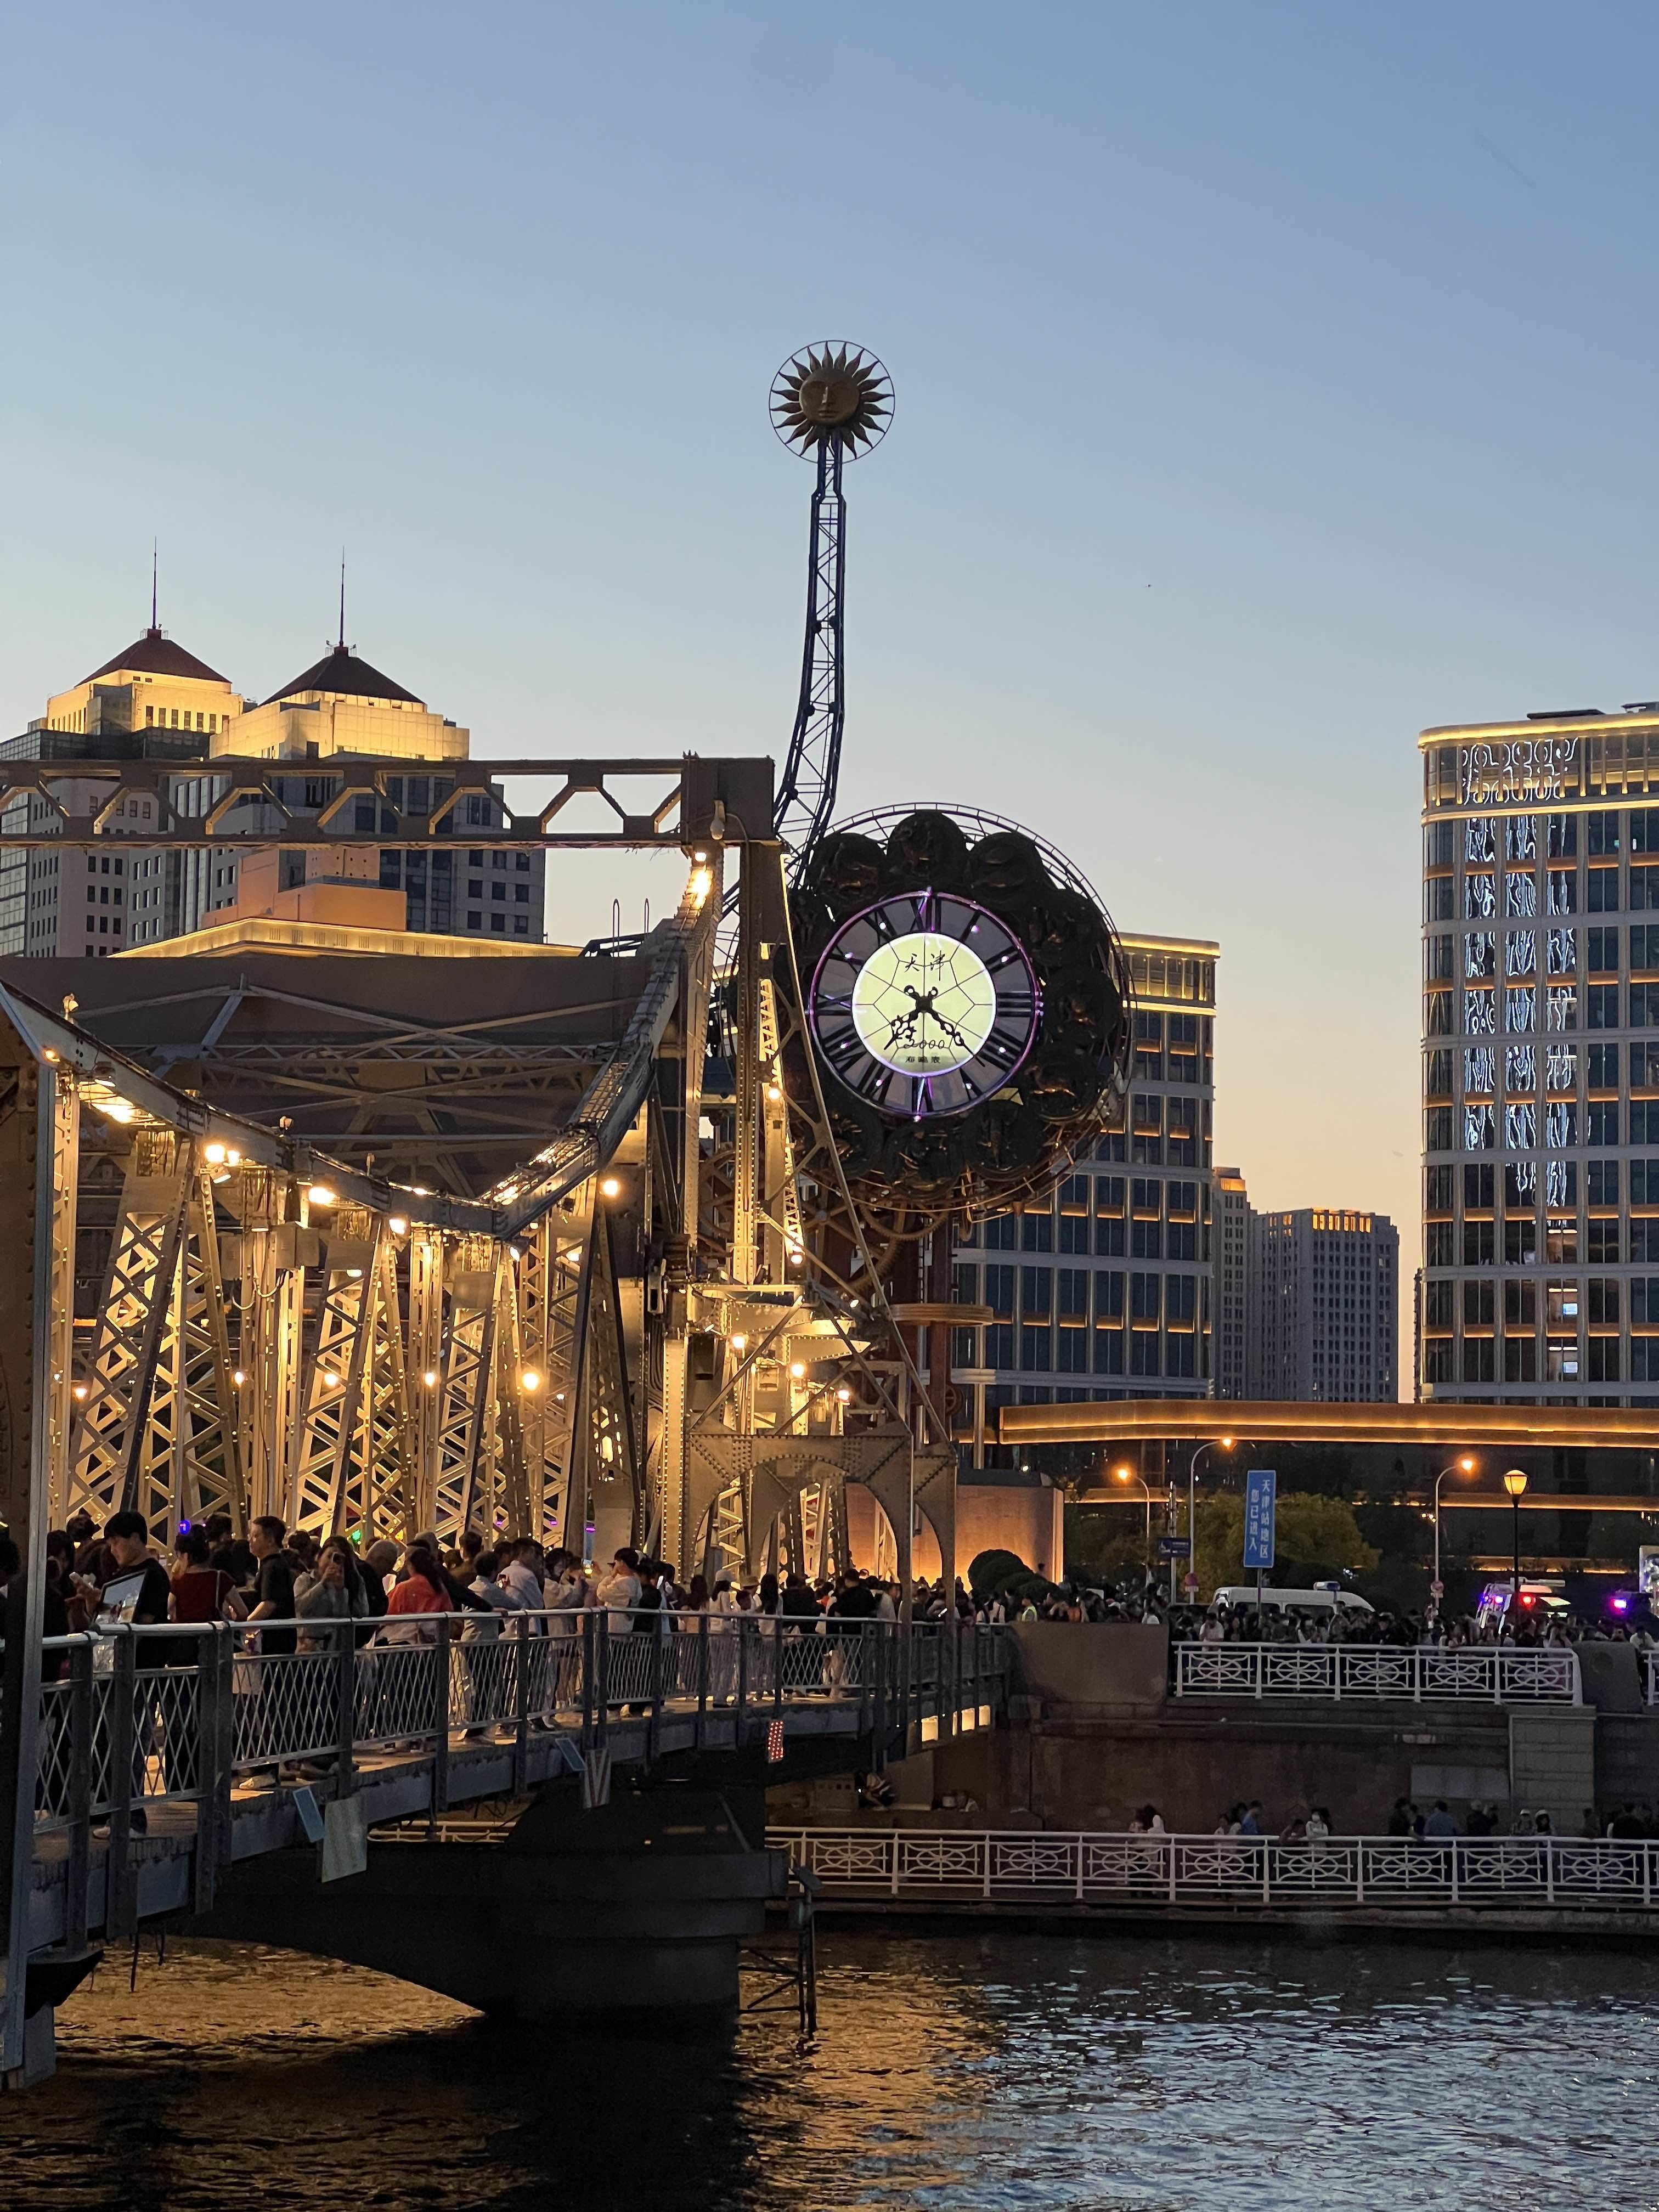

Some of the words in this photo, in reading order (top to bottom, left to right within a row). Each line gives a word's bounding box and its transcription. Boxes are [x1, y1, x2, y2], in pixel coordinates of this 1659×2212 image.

[904, 950, 945, 981] 天津
[904, 1039, 945, 1049] 2000
[1249, 1488, 1259, 1550] 您已进入
[1260, 1479, 1271, 1559] 天津站地区
